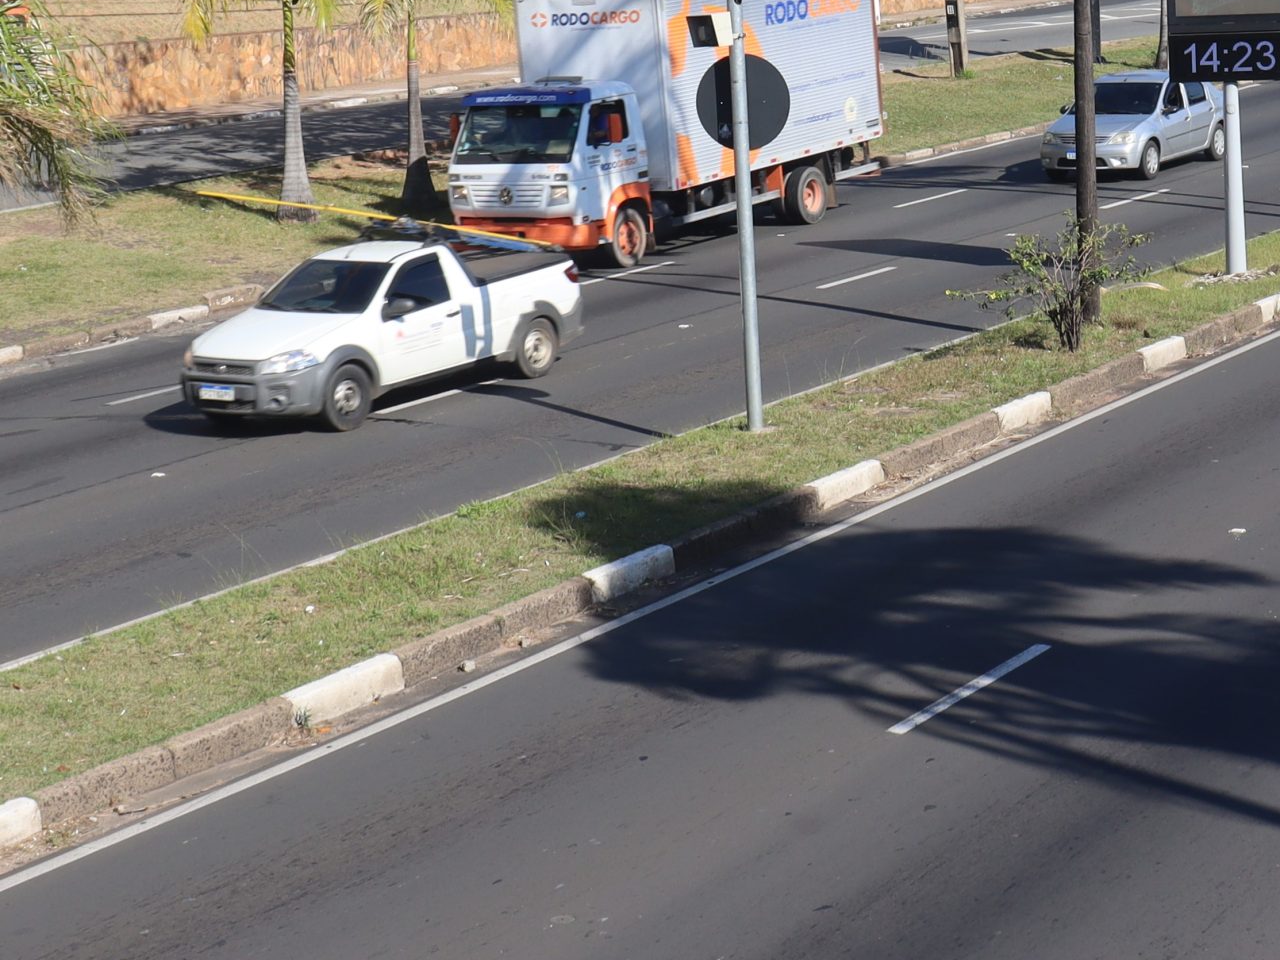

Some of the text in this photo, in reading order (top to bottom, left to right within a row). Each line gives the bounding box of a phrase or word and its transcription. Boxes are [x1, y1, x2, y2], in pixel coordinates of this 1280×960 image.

[551, 9, 641, 27] RODOCARGO
[1183, 40, 1277, 74] 14:23
[475, 93, 557, 104] www.rodocargo.com
